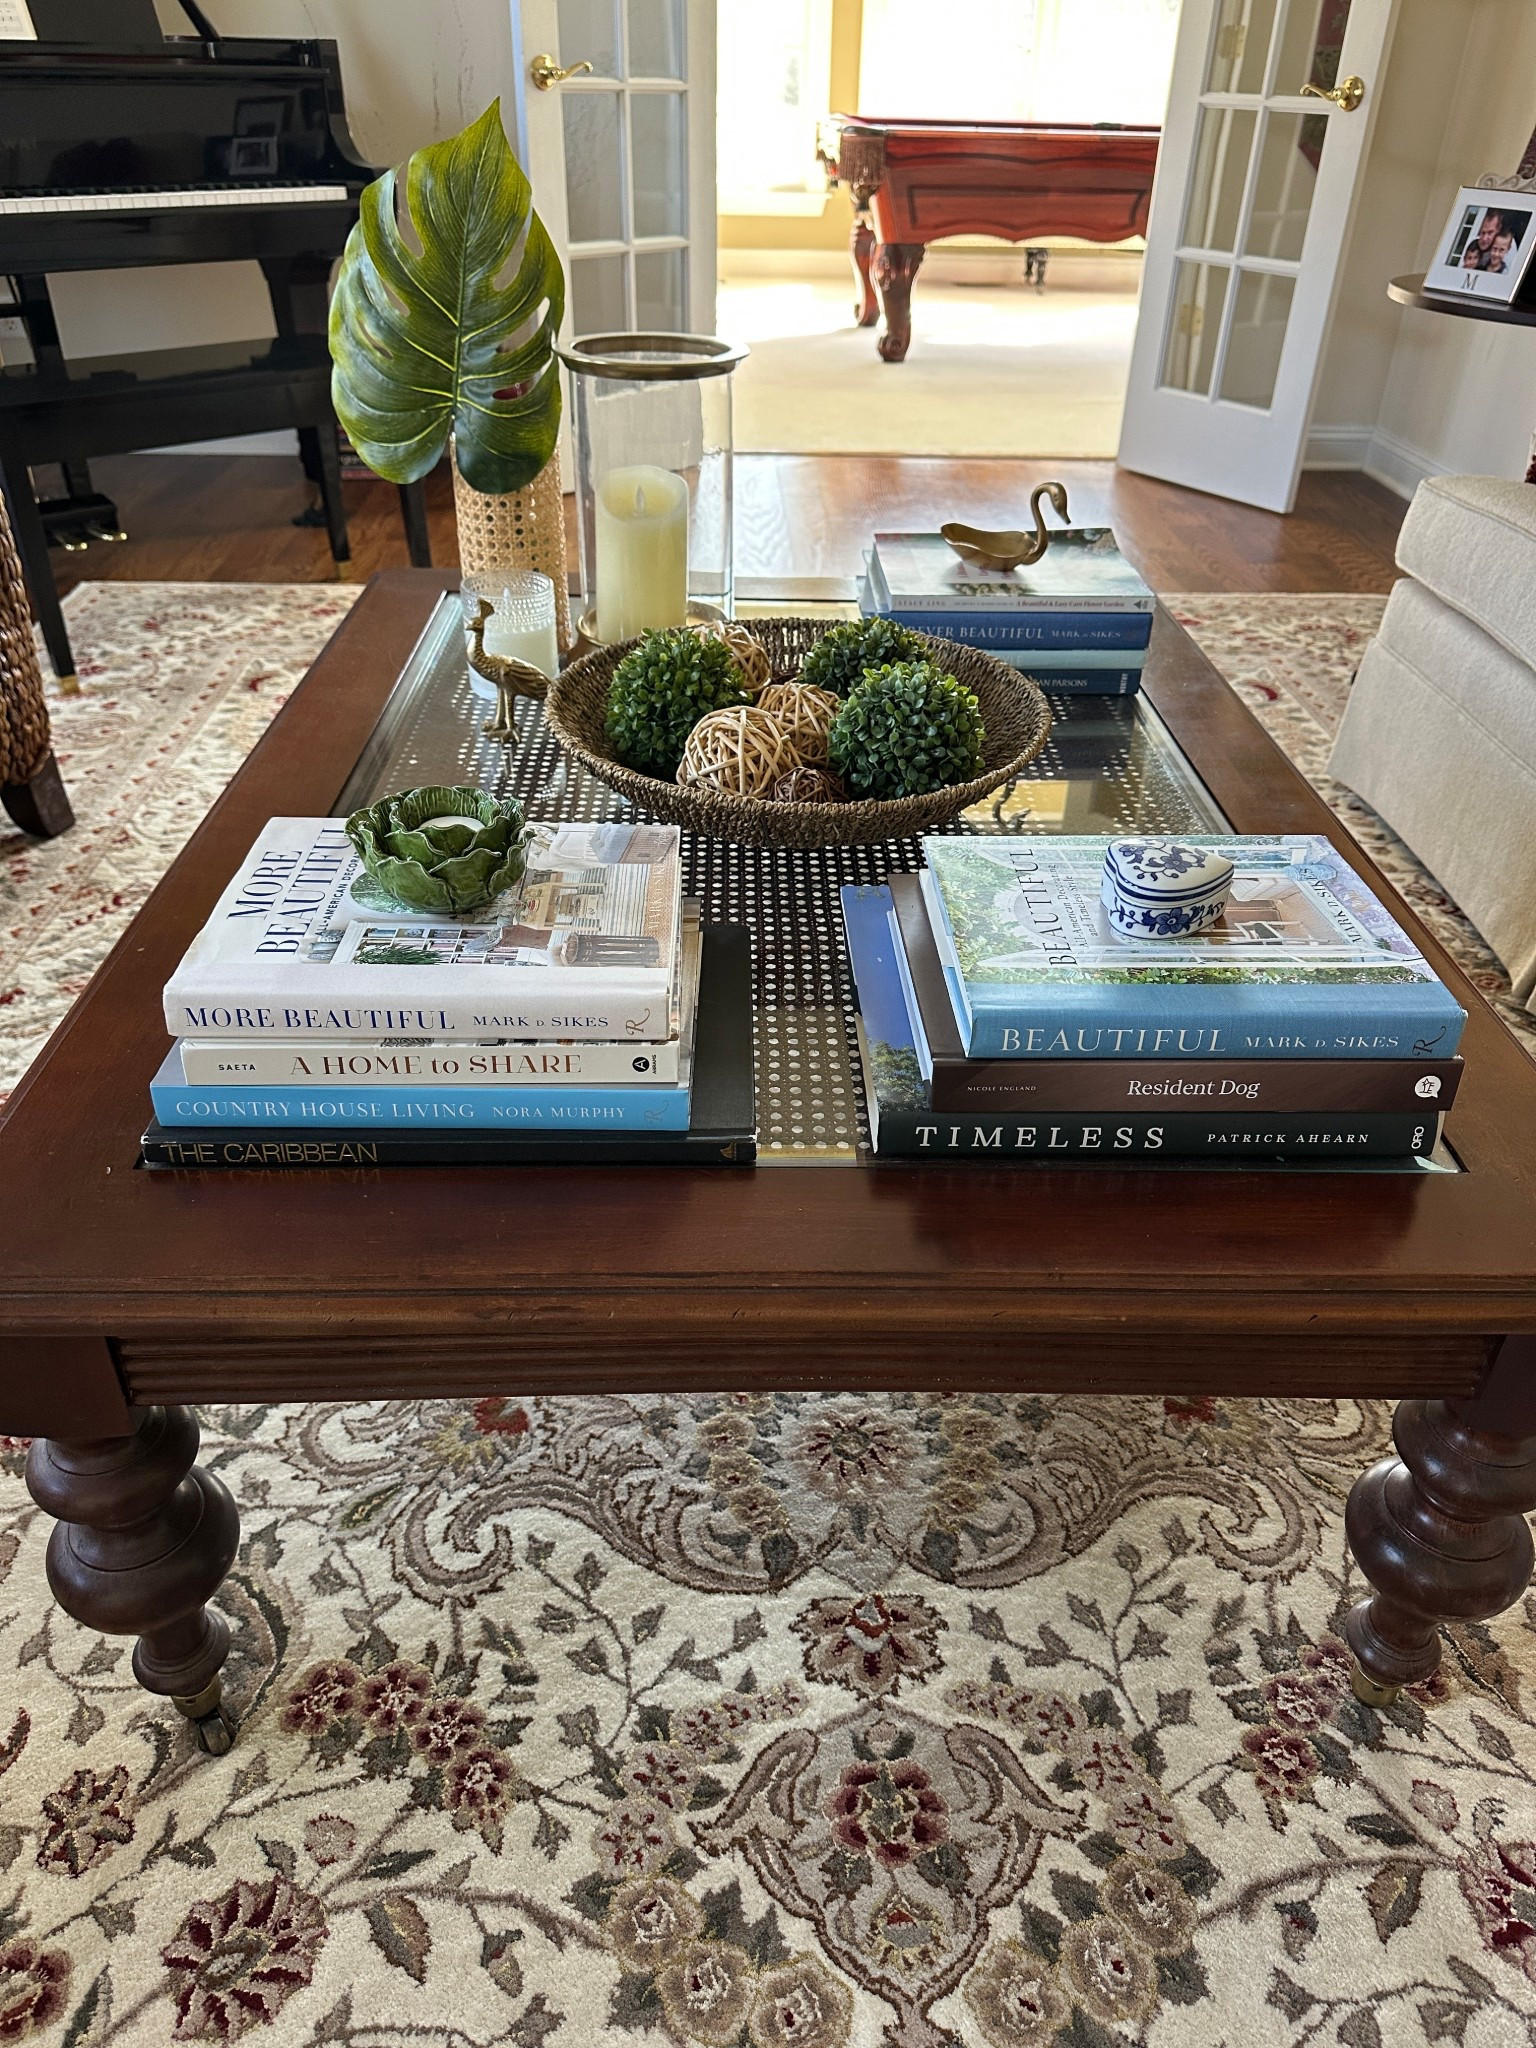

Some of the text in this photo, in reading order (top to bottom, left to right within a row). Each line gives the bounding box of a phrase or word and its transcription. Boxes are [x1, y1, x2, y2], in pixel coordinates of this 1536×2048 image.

[1460, 273, 1480, 291] M
[959, 626, 1045, 639] BEAUTIFUL
[1051, 630, 1080, 638] MARK
[1089, 630, 1121, 638] SIKES
[1052, 679, 1088, 687] PARSONS
[226, 850, 303, 920] MORE
[1300, 868, 1332, 898] SIKES
[648, 897, 663, 929] MARK
[1009, 848, 1078, 966] BEAUTIFUL
[1048, 864, 1090, 948] All-American Decorating
[1063, 875, 1099, 937] and Timeless Style
[1334, 911, 1363, 943] MARK
[185, 1008, 275, 1027] MORE
[284, 1009, 455, 1029] BEAUTIFUL
[472, 1015, 529, 1027] MARK
[551, 1016, 609, 1027] SIKES
[1001, 1028, 1226, 1052] BEAUTIFUL
[1245, 1036, 1308, 1048] MARK
[1333, 1036, 1399, 1048] SIKES
[291, 1054, 582, 1075] A HOME to SHARE
[1127, 1079, 1261, 1099] Resident Dog
[176, 1101, 475, 1118] COUNTRY HOUSE LIVING
[492, 1106, 627, 1118] NORA MURPHY
[915, 1126, 1165, 1149] TIMELESS
[1207, 1134, 1370, 1143] PATRICK AHEARN
[160, 1143, 378, 1163] THE CARIBBEAN
